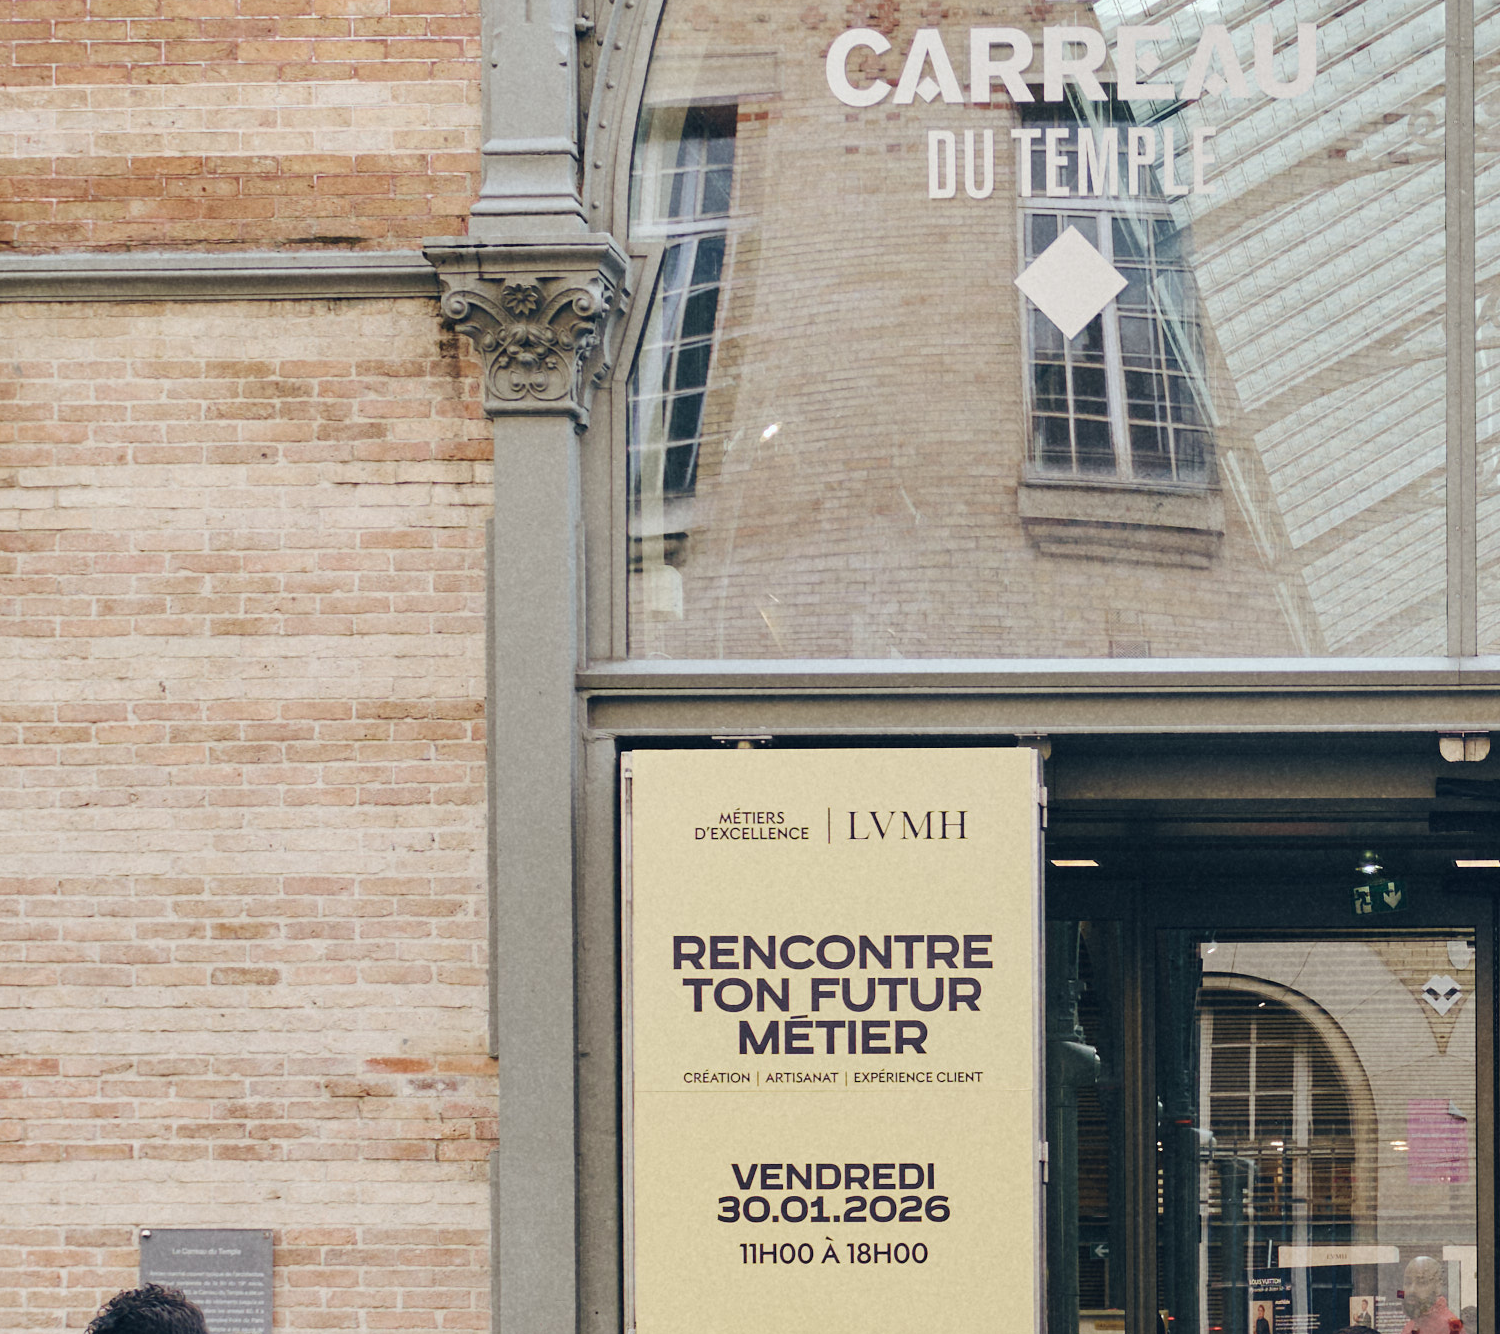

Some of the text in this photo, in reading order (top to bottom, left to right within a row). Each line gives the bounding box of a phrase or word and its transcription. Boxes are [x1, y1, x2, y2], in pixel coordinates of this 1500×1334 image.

[825, 23, 1318, 107] CARREAU
[927, 126, 1216, 200] DU TEMPLE
[719, 808, 784, 824] MÉTIERS
[849, 811, 967, 839] LVMH
[694, 826, 809, 840] D'EXCELLENCE
[673, 935, 993, 969] RENCONTRE
[683, 978, 981, 1012] TON FUTUR
[739, 1015, 927, 1054] MÉTIER
[684, 1069, 983, 1083] CRÉATION ARTISANAT EXPÉRIENCE CLIENT
[731, 1163, 934, 1190] VENDREDI
[718, 1196, 950, 1223] 30.01.2026
[740, 1237, 928, 1264] 11H00 À 18H00
